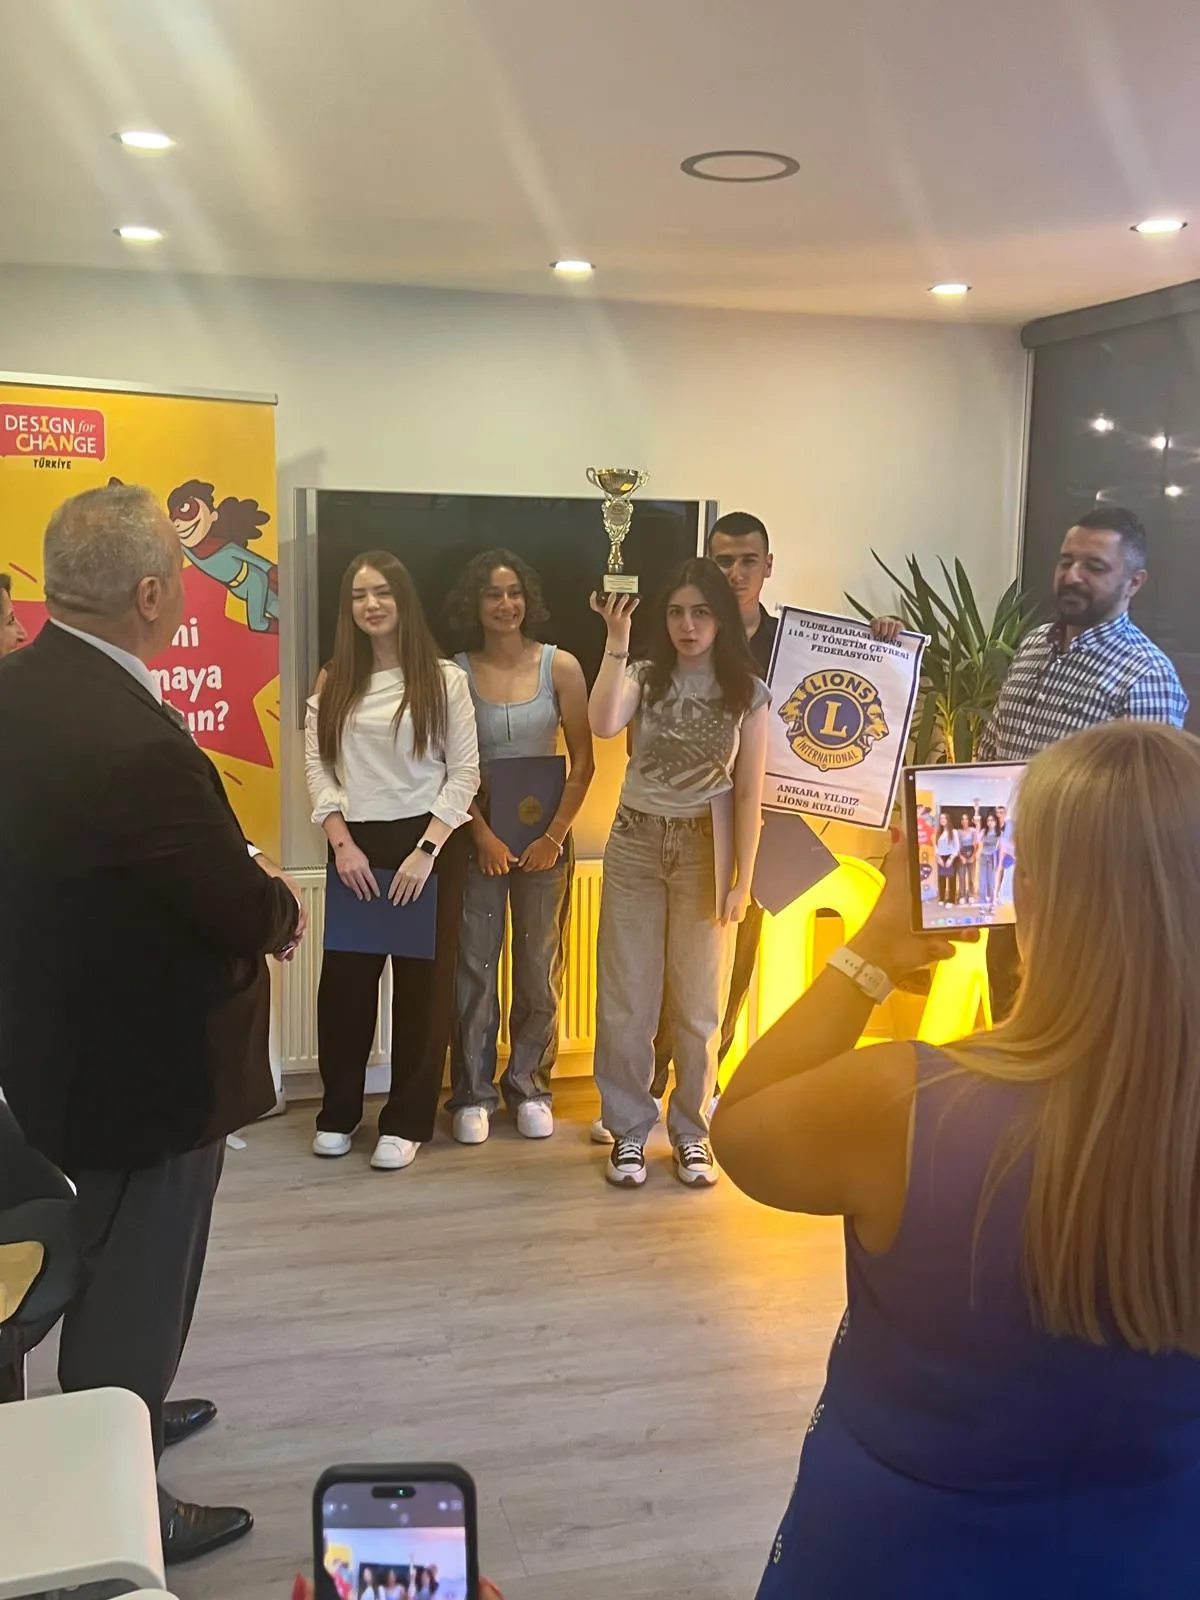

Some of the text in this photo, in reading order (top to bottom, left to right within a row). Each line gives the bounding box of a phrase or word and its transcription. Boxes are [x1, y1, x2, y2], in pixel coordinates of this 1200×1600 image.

[5, 414, 96, 435] DESIGN for
[16, 432, 96, 453] CHANGE
[33, 457, 72, 469] TÜRKİYE
[172, 617, 199, 647] ni
[822, 634, 867, 650] YÖNETİM
[811, 645, 883, 663] FEDERASYONU
[149, 665, 222, 703] maya
[809, 674, 873, 700] LIONS
[187, 700, 229, 732] ın?
[820, 701, 847, 738] L
[797, 740, 860, 764] INTERNATIONAL
[777, 784, 860, 806] ANKARA YILDIZ
[811, 801, 855, 816] KULÜBÜ
